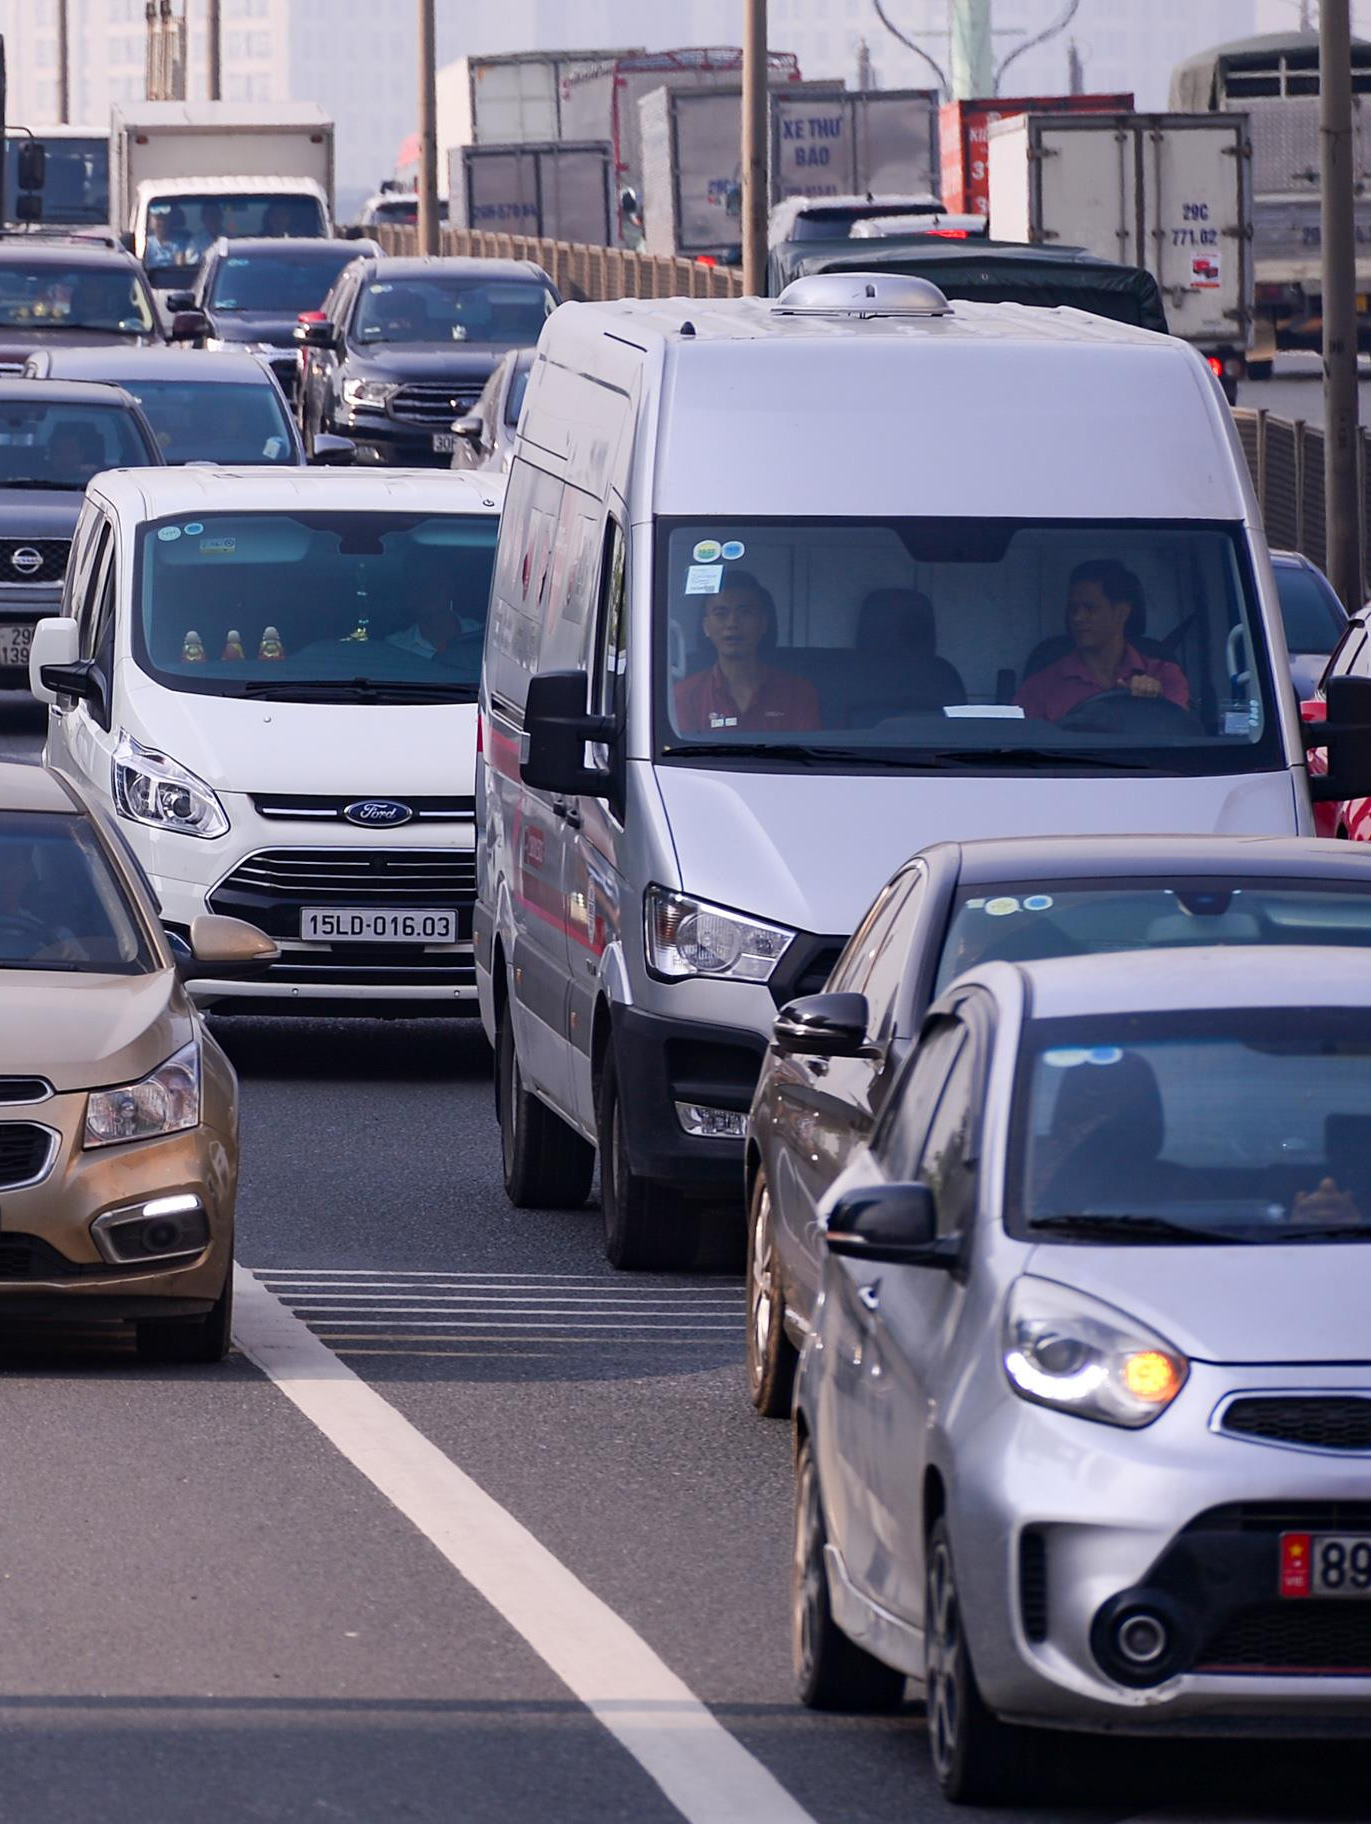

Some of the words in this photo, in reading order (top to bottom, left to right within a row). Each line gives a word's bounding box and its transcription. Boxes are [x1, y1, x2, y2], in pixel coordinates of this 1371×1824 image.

[783, 119, 804, 139] XE
[1182, 203, 1208, 220] 29C
[359, 803, 398, 820] Ford
[310, 914, 450, 937] 15LD-016.03
